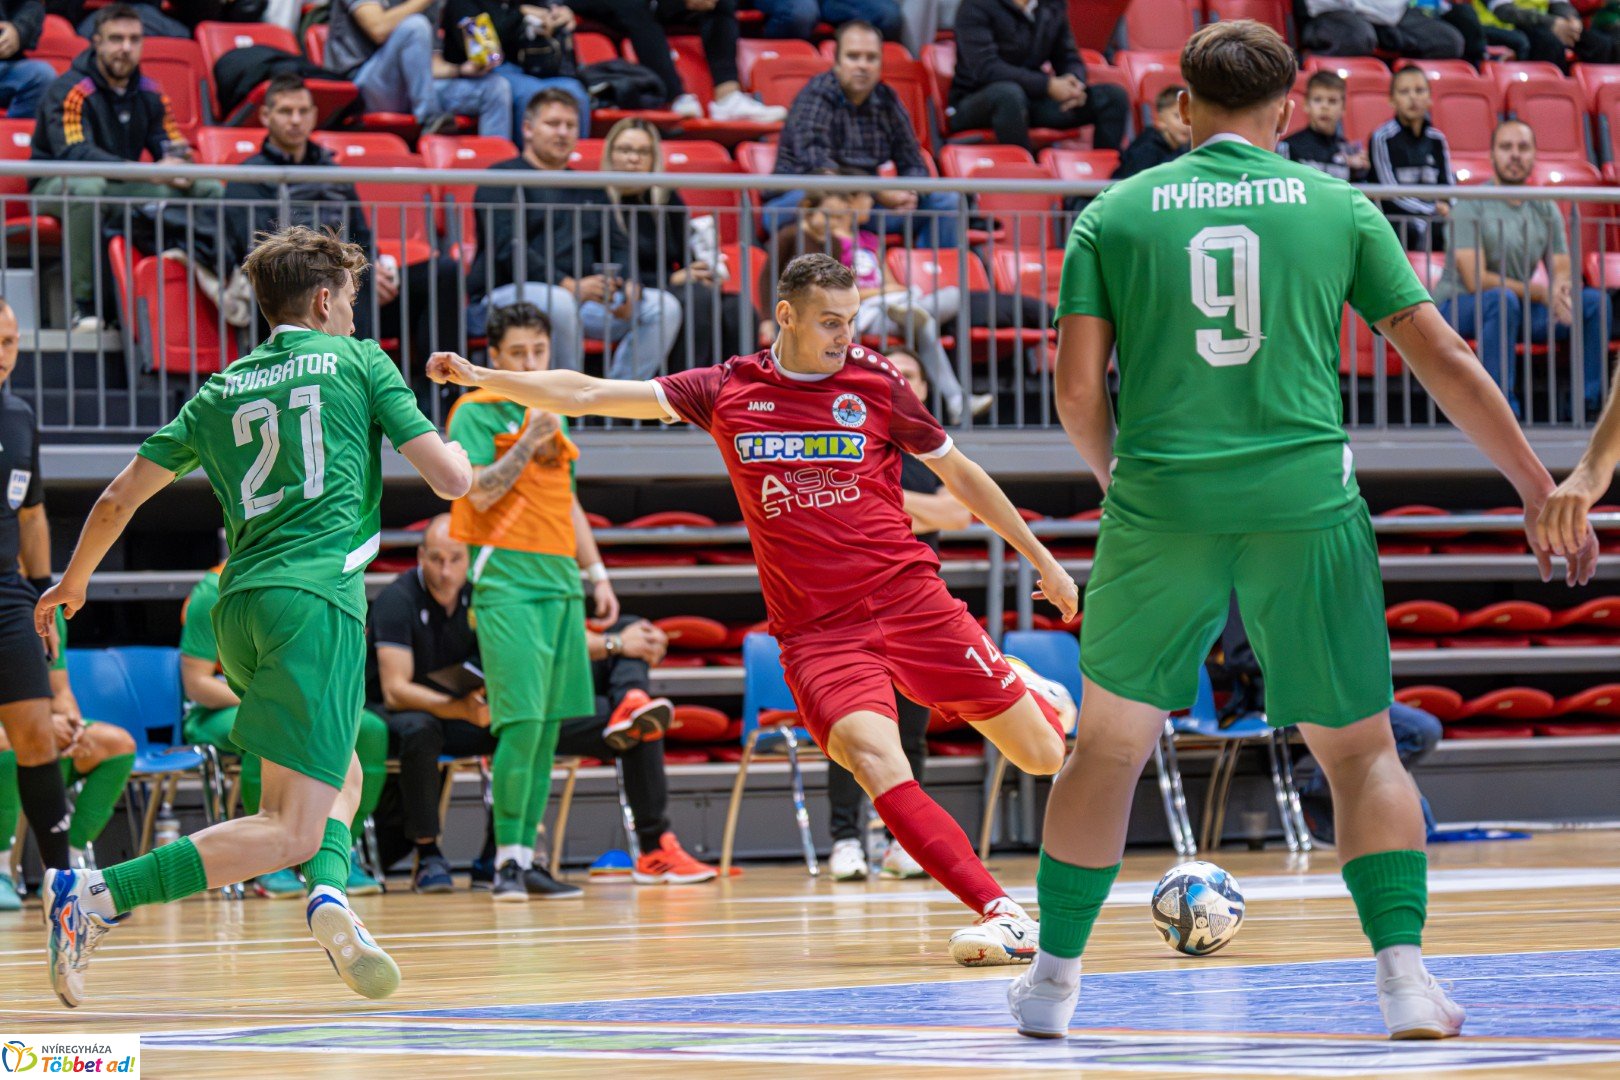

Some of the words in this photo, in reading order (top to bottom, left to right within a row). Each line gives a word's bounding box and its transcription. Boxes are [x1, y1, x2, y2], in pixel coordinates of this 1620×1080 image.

[1152, 173, 1307, 212] NYÍRBÁTOR
[1185, 224, 1266, 367] 9
[223, 352, 338, 399] NYÍRBÁTOR
[747, 401, 775, 411] JAKO
[231, 385, 326, 520] 21
[763, 486, 861, 519] STUDIO
[965, 634, 1006, 677] 14
